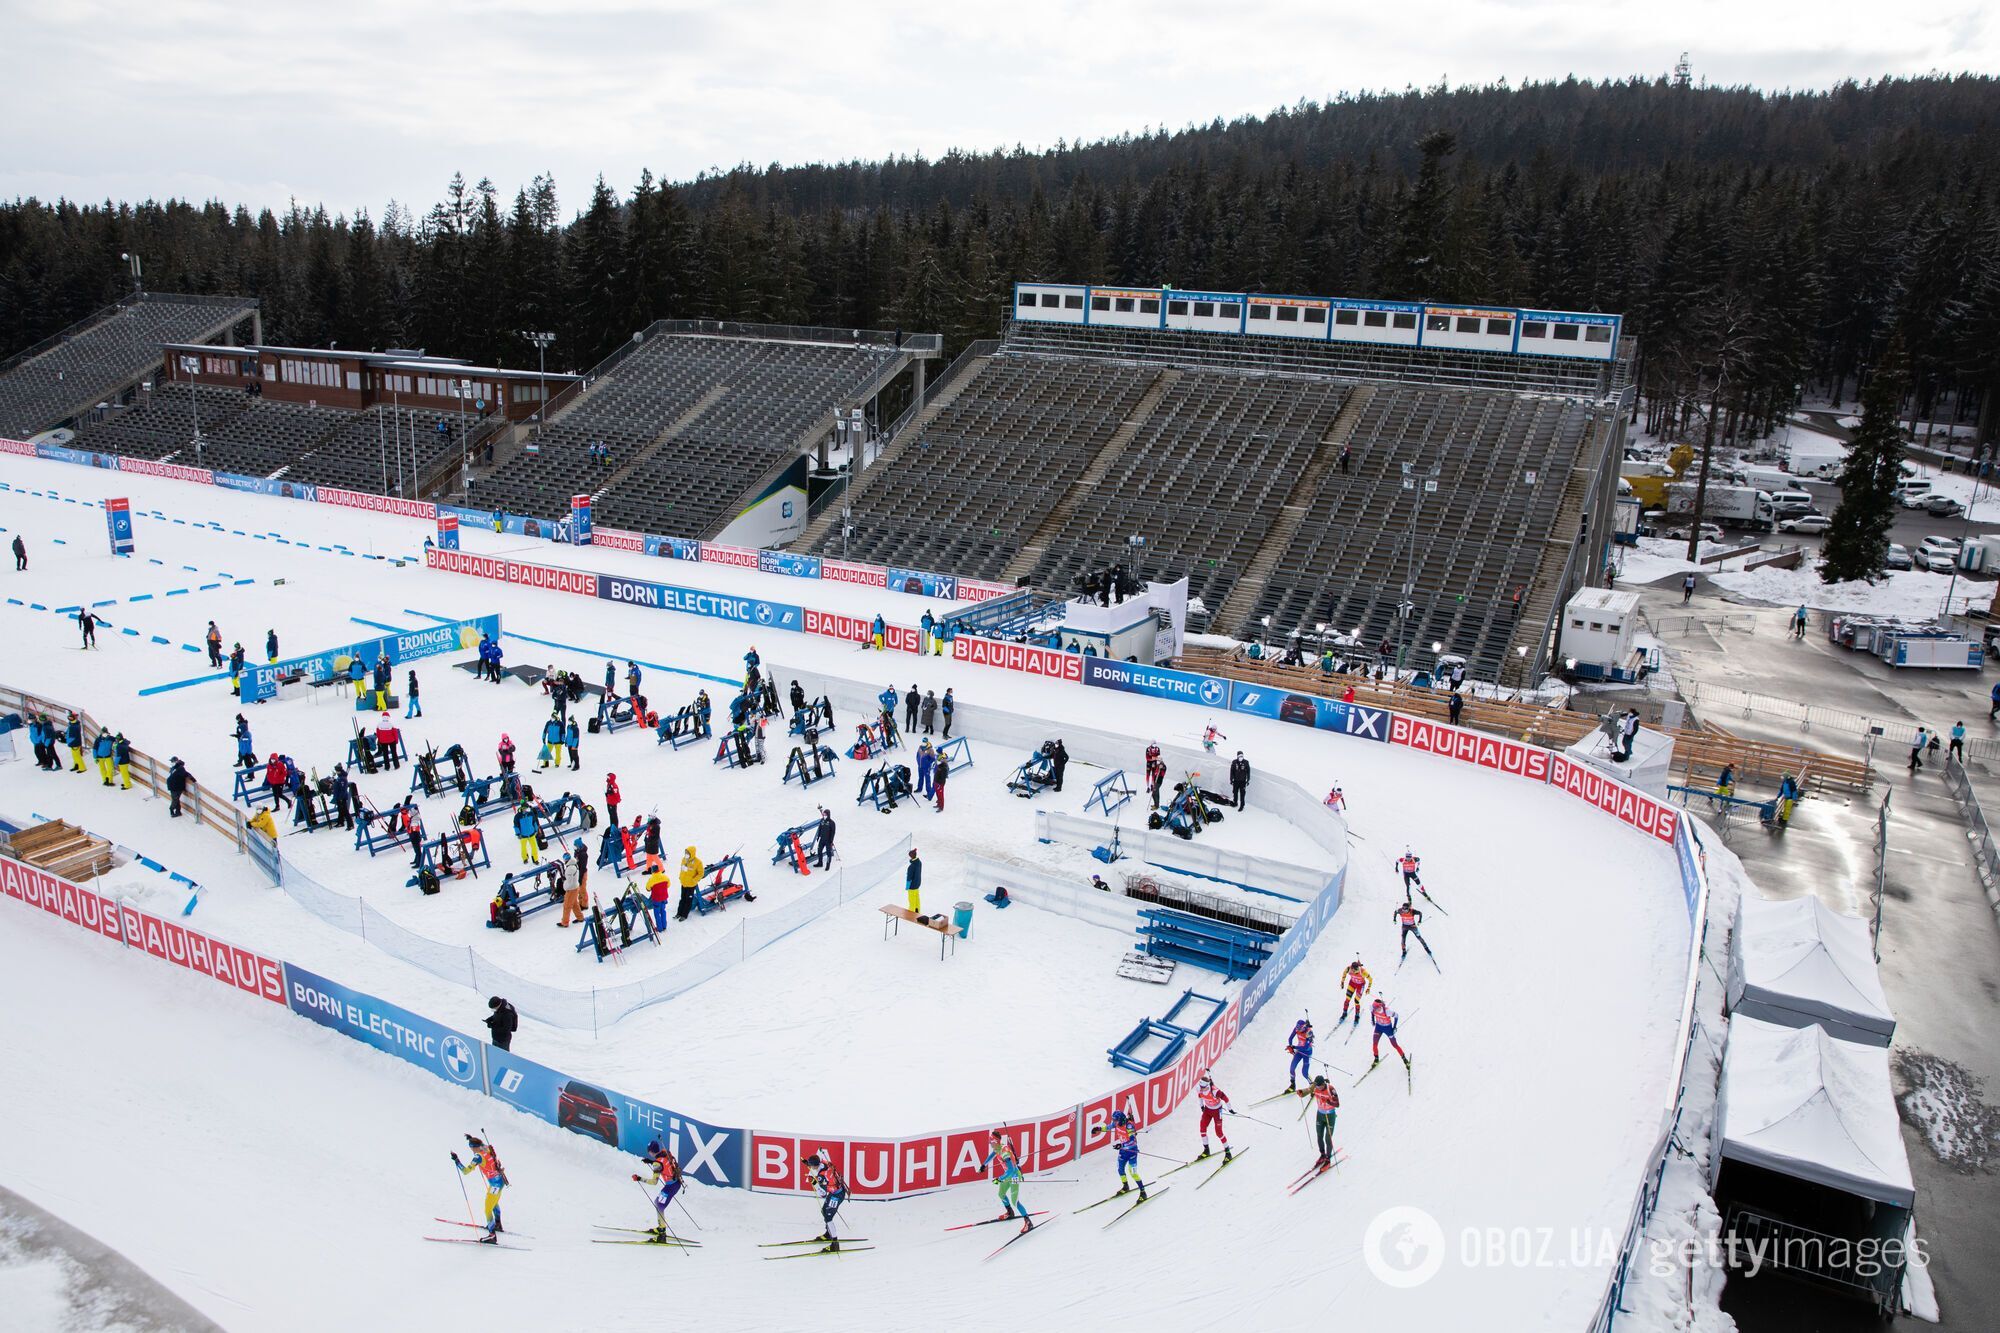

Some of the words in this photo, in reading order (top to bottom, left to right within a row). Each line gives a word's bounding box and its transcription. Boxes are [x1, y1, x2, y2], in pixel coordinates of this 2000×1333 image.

[120, 459, 164, 476] BAUHAUS
[166, 465, 213, 484] BAUHAUS
[216, 476, 230, 486] BORN
[230, 479, 252, 488] ELECTRIC
[319, 489, 375, 509] BAUHAUS
[376, 497, 436, 518] BAUHAUS
[458, 514, 487, 525] ELECTRIC
[594, 534, 643, 552] BAUHAUS
[682, 545, 696, 560] iX
[428, 552, 506, 578] BAUHAUS
[702, 549, 758, 566] BAUHAUS
[761, 556, 779, 566] BORN
[761, 563, 792, 574] ELECTRIC
[509, 563, 596, 593] BAUHAUS
[823, 568, 887, 587] BAUHAUS
[611, 581, 658, 605] BORN
[664, 590, 750, 620] ELECTRIC
[935, 582, 952, 599] iX
[398, 627, 453, 652] ERDINGER
[807, 614, 918, 650] BAUHUS
[399, 642, 453, 661] ALKOHOLFREI
[956, 640, 1081, 678] BAUHAUS
[1093, 667, 1130, 684] BORN
[1133, 674, 1197, 695] ELECTRIC
[1324, 701, 1346, 715] THE
[1346, 706, 1382, 738] iX
[1393, 720, 1546, 777] BAUHAUS
[1554, 760, 1674, 839] BAUHAUS
[0, 864, 120, 936] AUHAUS
[124, 911, 281, 997] BAUHAUS
[1243, 982, 1268, 1016] BORN
[1268, 932, 1303, 986] ELECTRIC
[294, 981, 342, 1020] BORN
[346, 1004, 436, 1059] ELECTRIC
[1085, 1003, 1239, 1147] BAUHAUS
[625, 1101, 664, 1132] THE
[668, 1117, 731, 1183] iX
